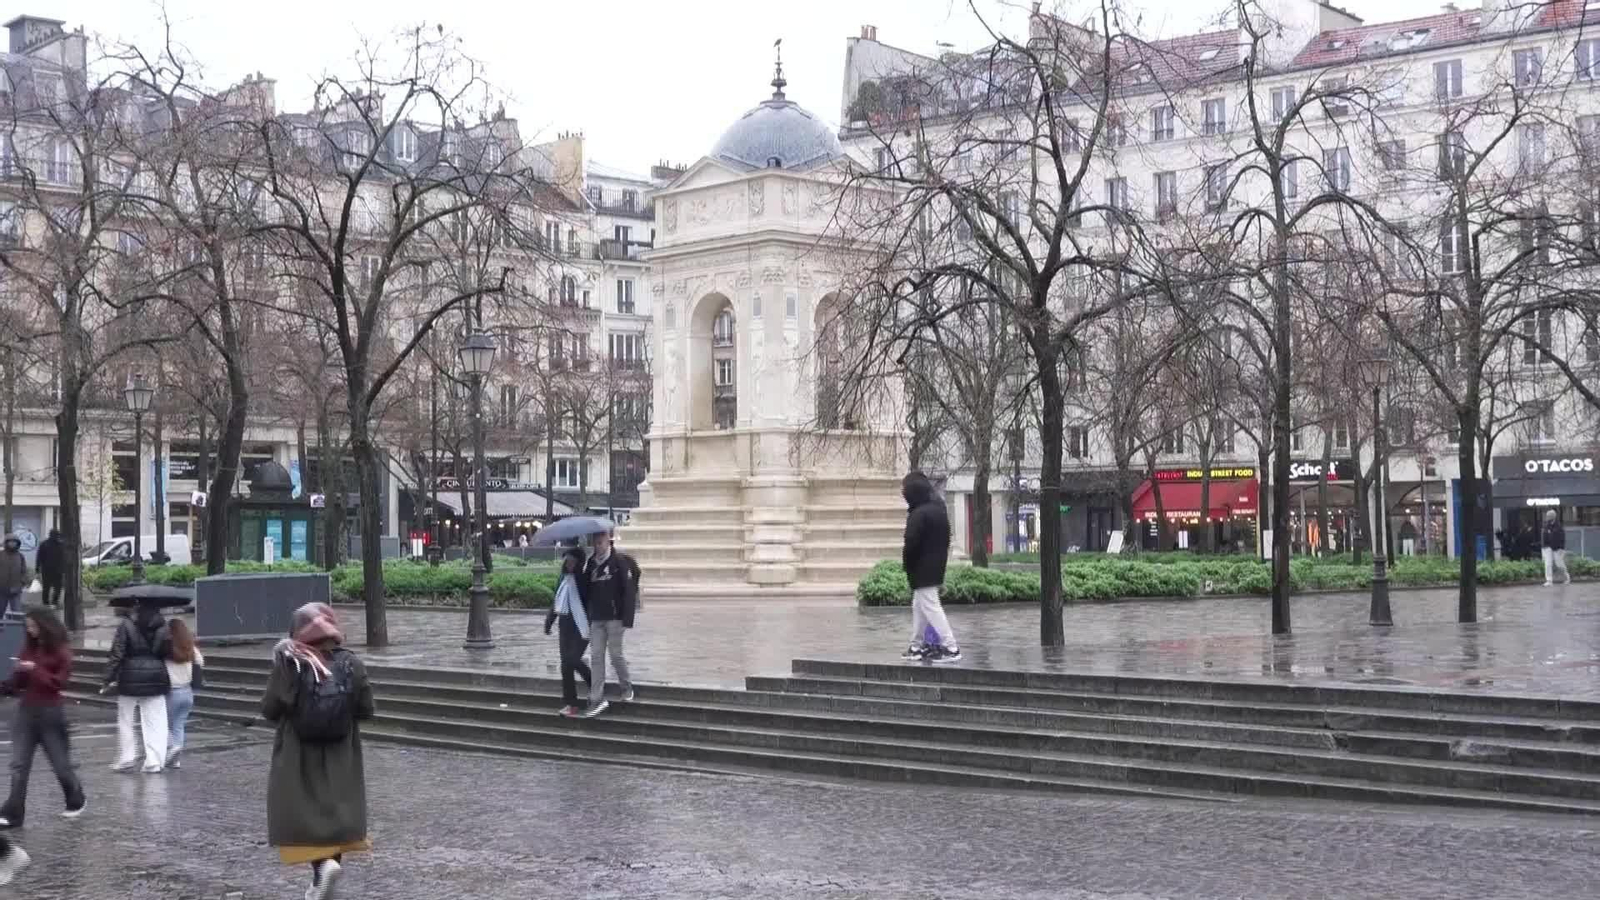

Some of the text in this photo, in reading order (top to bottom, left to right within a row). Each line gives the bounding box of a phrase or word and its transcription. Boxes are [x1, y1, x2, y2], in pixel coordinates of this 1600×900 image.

[1289, 462, 1336, 479] Schot
[1525, 458, 1593, 472] O'TACOS
[1211, 470, 1232, 478] STREET
[1234, 469, 1253, 477] FOOD
